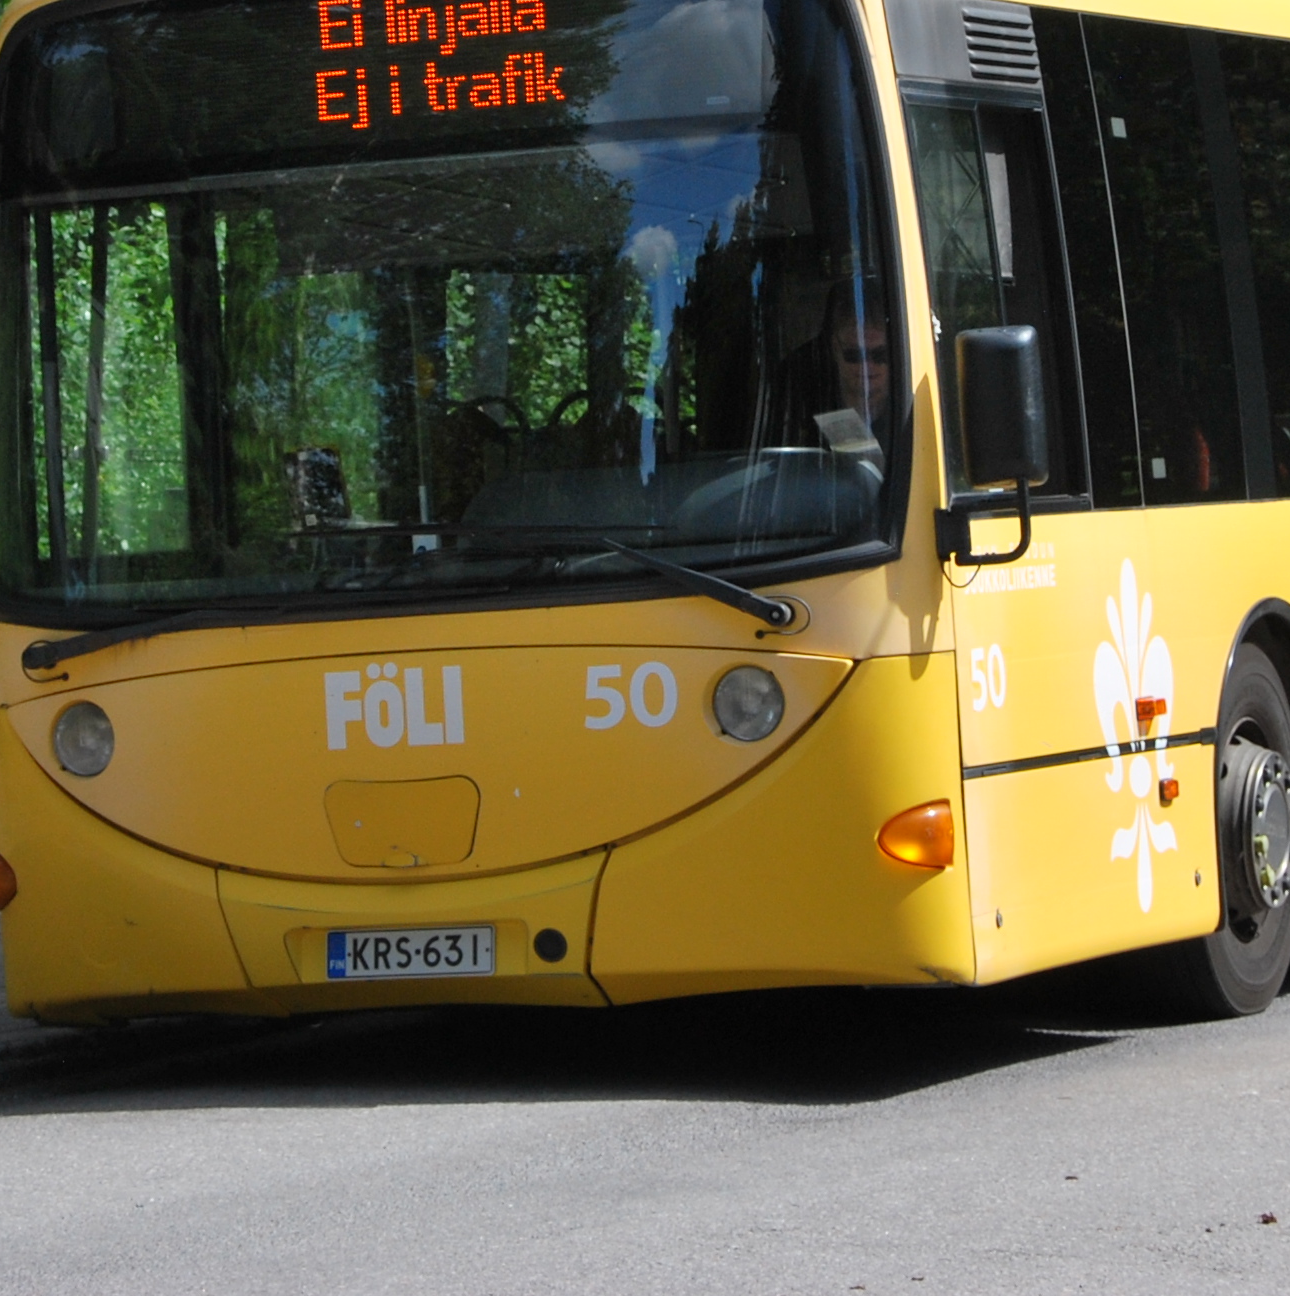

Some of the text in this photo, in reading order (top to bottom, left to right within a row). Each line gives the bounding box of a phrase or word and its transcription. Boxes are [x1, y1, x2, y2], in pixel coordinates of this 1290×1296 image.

[315, 52, 566, 129] Ej i trafik
[964, 564, 1056, 594] JOUKKOLIIKENNE
[324, 662, 465, 750] FÖLI
[584, 661, 678, 730] 50
[970, 643, 1007, 712] 50
[329, 933, 479, 971] FIN KRS-631
